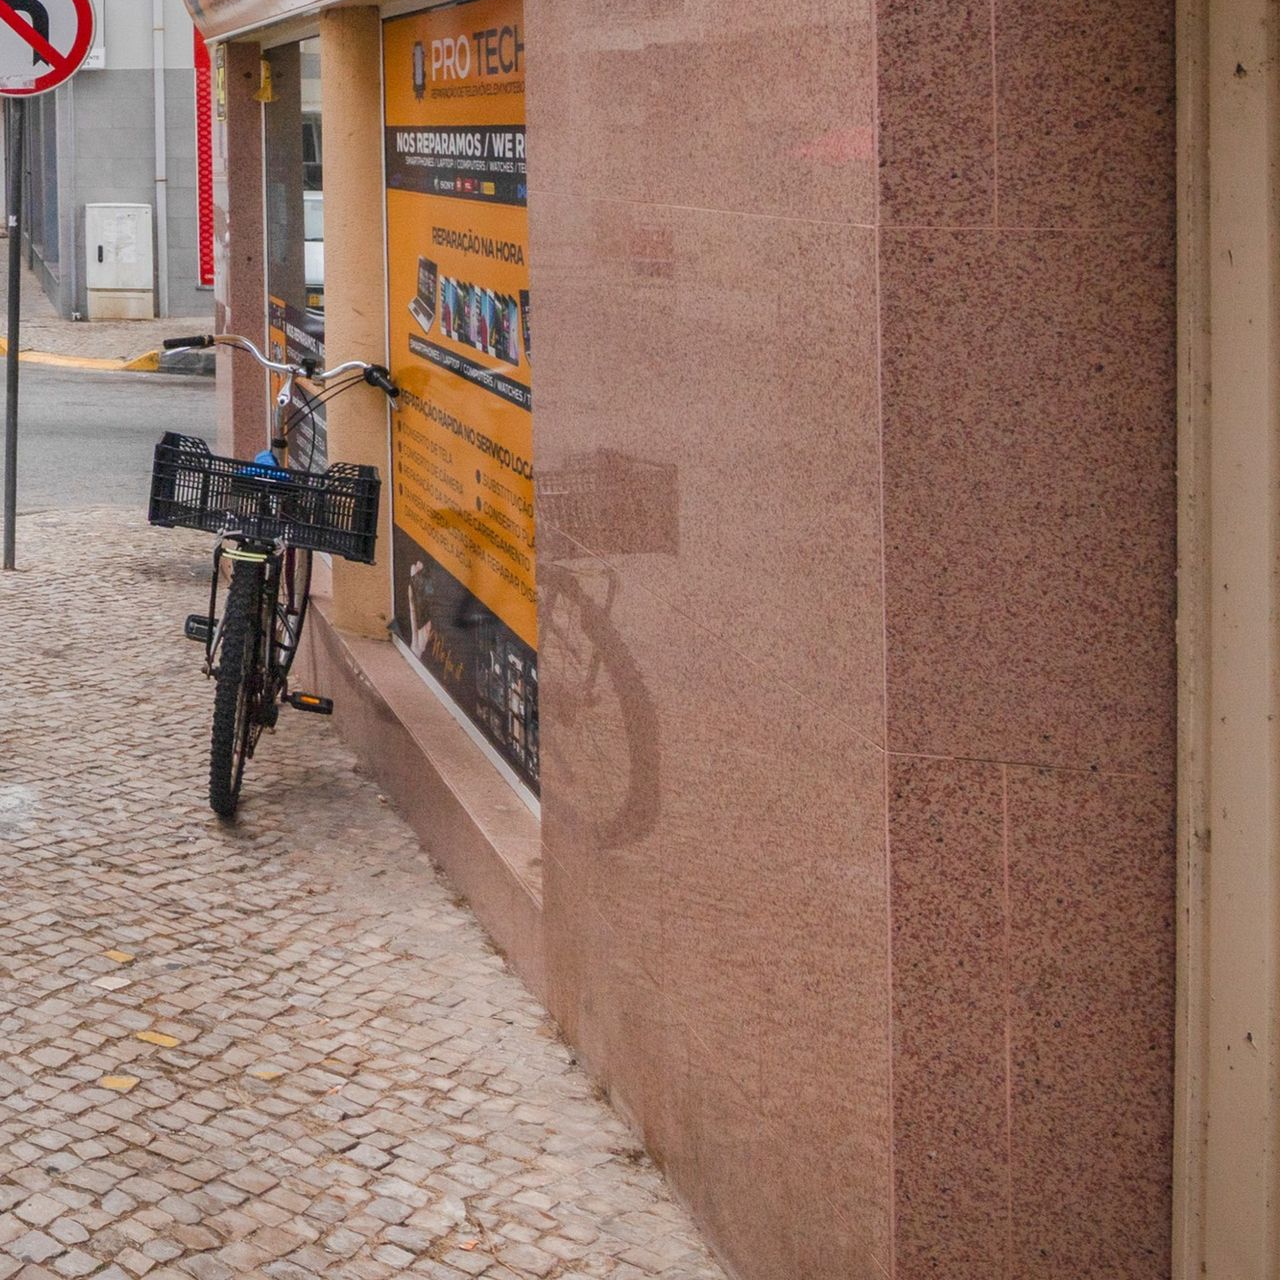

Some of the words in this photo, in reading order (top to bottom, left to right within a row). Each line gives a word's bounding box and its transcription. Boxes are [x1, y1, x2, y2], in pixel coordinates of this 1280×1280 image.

[431, 34, 471, 81] PRO
[397, 132, 415, 153] NOS
[416, 132, 481, 157] REPARAMOS
[492, 133, 513, 158] WE
[515, 133, 526, 159] R
[457, 159, 486, 171] COMPUTERS
[490, 161, 514, 173] WATCHES
[432, 226, 480, 257] REPARAÇÃO
[481, 237, 495, 259] NA
[496, 240, 525, 266] HORA
[463, 363, 493, 387] COMPUTERS
[497, 381, 523, 402] WATCHES
[463, 423, 475, 446] NO
[475, 430, 510, 472] SERVIÇO
